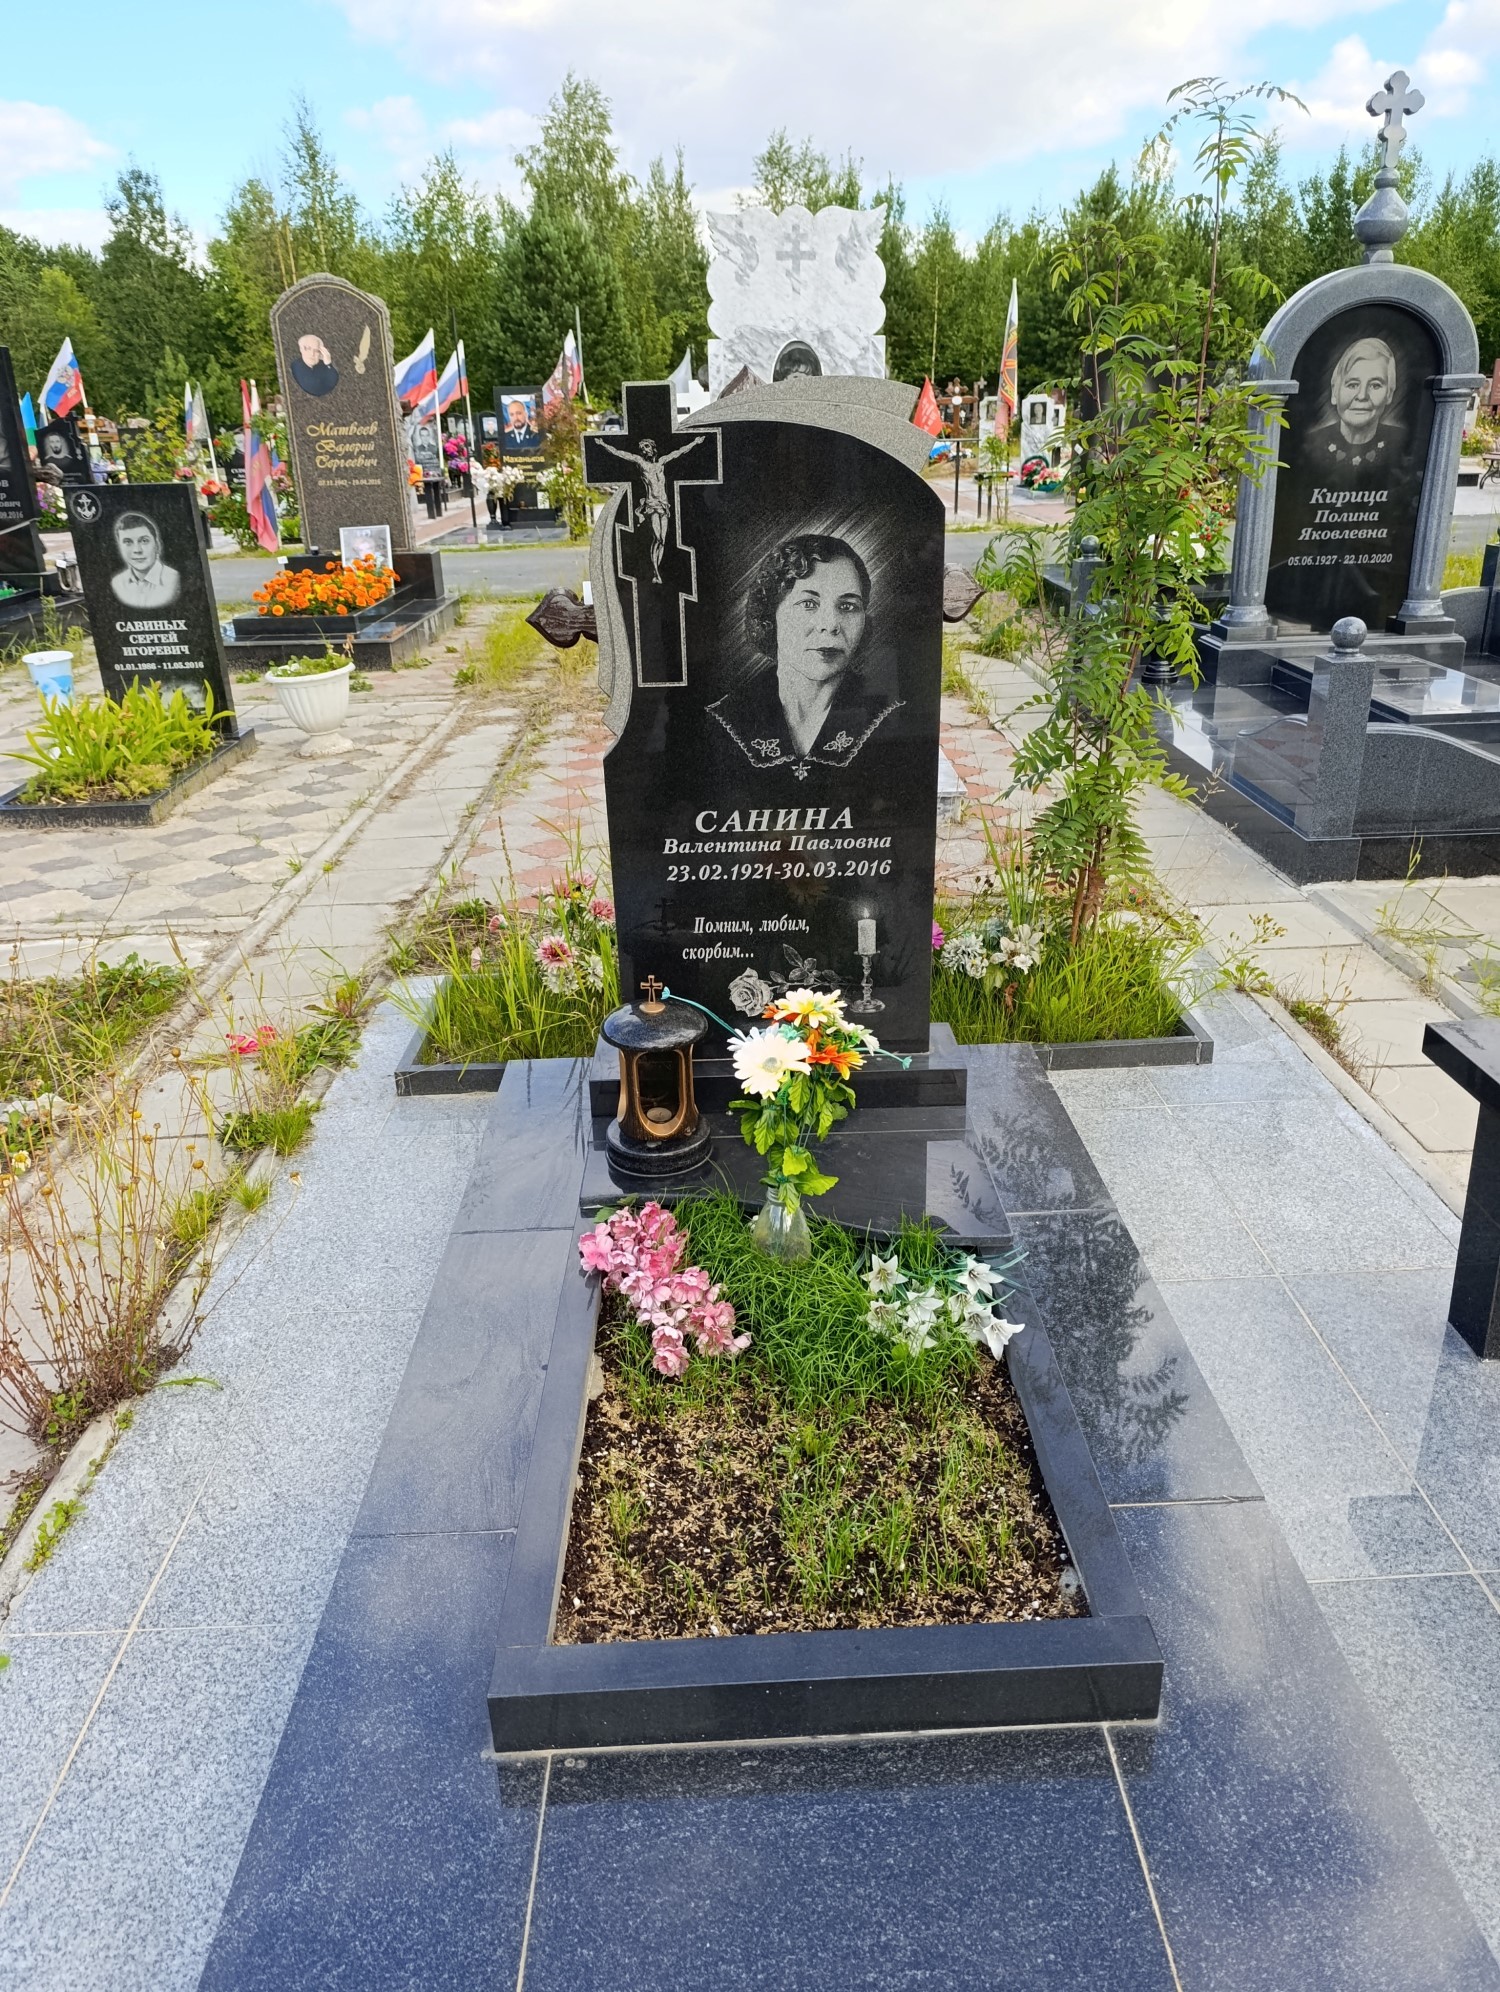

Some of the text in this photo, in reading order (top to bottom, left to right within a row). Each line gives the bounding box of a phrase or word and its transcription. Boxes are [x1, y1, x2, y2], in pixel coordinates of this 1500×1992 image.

[306, 421, 378, 437] Матвеев
[315, 439, 375, 456] Валерий
[315, 454, 378, 473] Сергеевич
[1309, 487, 1389, 508] Кирица
[1313, 509, 1380, 523] Полина
[1298, 527, 1389, 541] Яковлевна
[1287, 555, 1337, 566] 05.06.1927
[1342, 553, 1393, 565] 22.10.2020
[115, 620, 188, 632] САВИНЫХ
[129, 631, 179, 644] СЕРГЕЙ
[121, 645, 190, 656] ИГОРЕВИЧ
[695, 806, 854, 833] САНИНА
[662, 835, 893, 855] Валентина Павловна
[666, 859, 893, 882] 23.02.1921-30.03.2016
[693, 913, 811, 935] Помним, любим,
[682, 941, 755, 963] скорбим...
